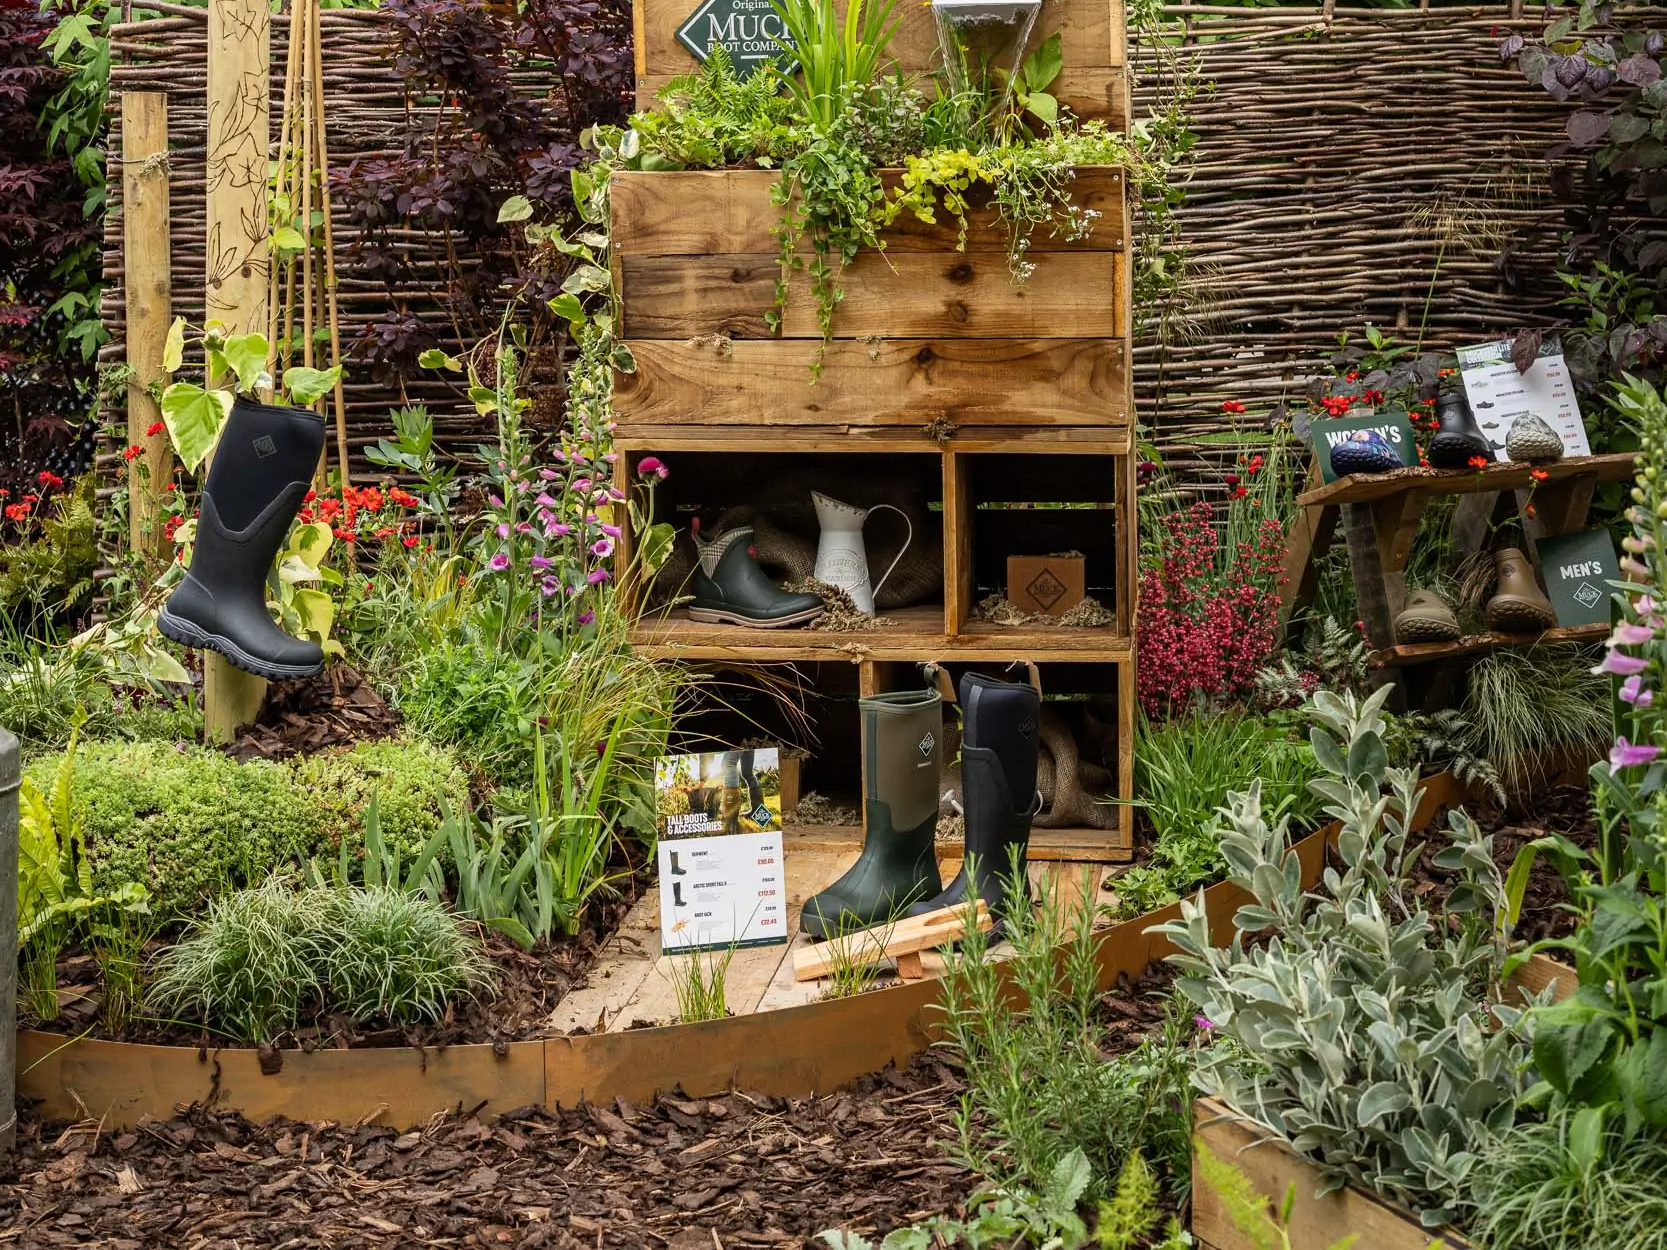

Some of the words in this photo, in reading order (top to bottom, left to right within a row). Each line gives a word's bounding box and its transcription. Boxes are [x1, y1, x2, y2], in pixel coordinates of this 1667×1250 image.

[743, 40, 800, 52] COMPAN
[1325, 424, 1401, 449] WON'S
[1560, 561, 1602, 579] MEN'S
[667, 815, 683, 825] TALL
[684, 813, 708, 824] BOOTS
[667, 826, 674, 835] &
[674, 821, 722, 834] ACCESSORIES
[758, 889, 776, 897] £112.50
